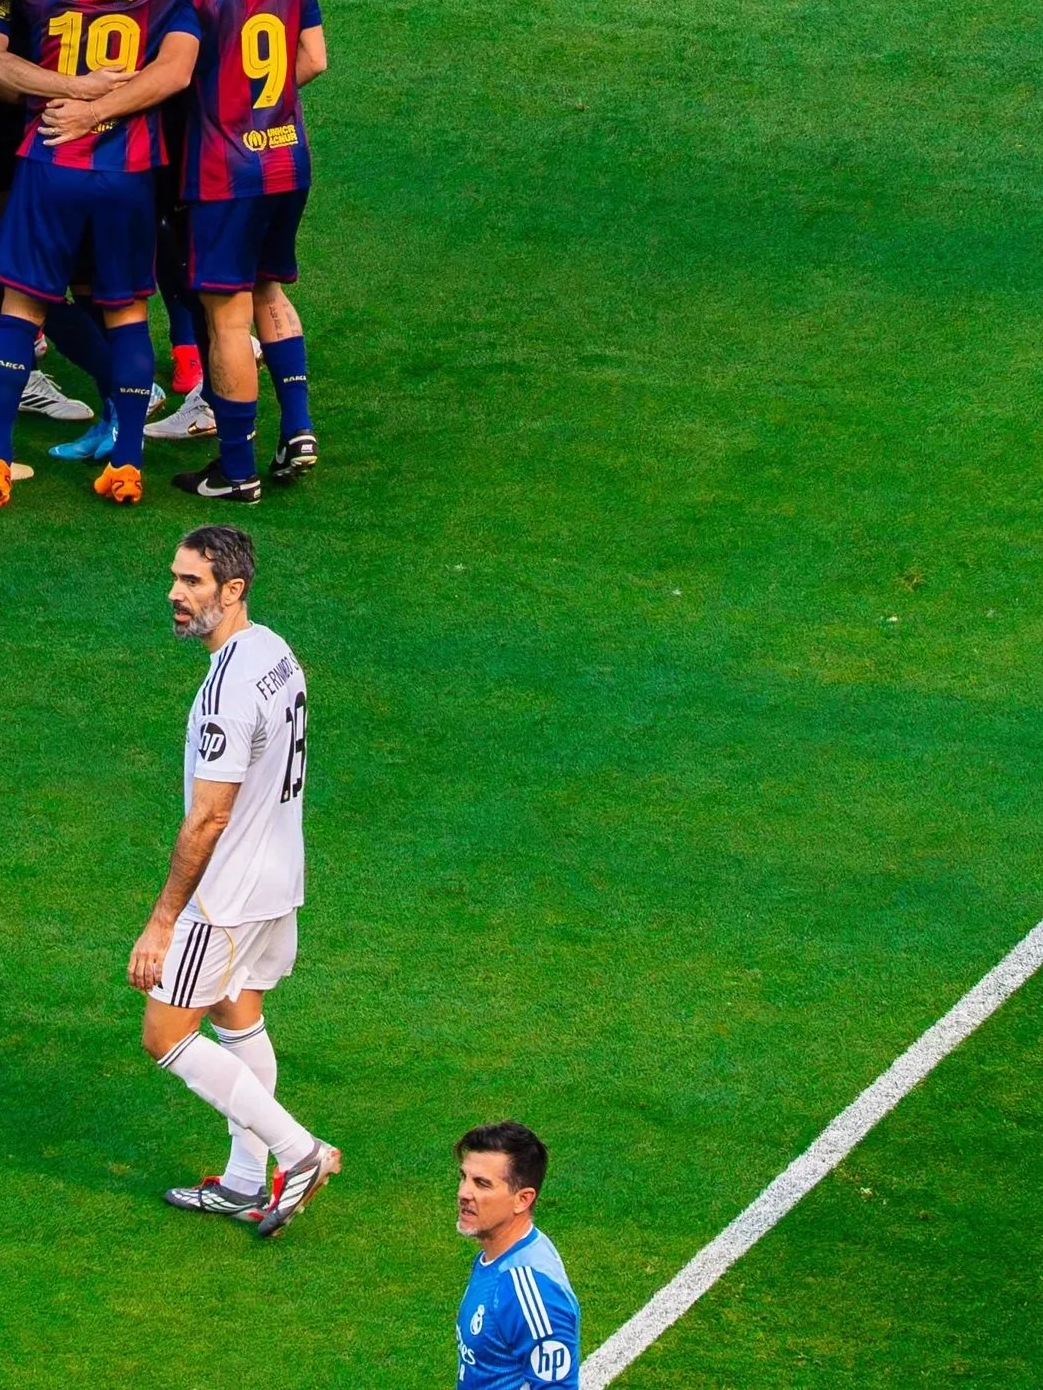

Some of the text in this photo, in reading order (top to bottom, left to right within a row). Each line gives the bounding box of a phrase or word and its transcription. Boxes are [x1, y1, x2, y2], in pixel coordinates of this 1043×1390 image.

[241, 13, 288, 109] 9
[199, 722, 226, 762] hp
[537, 1341, 566, 1381] hp
